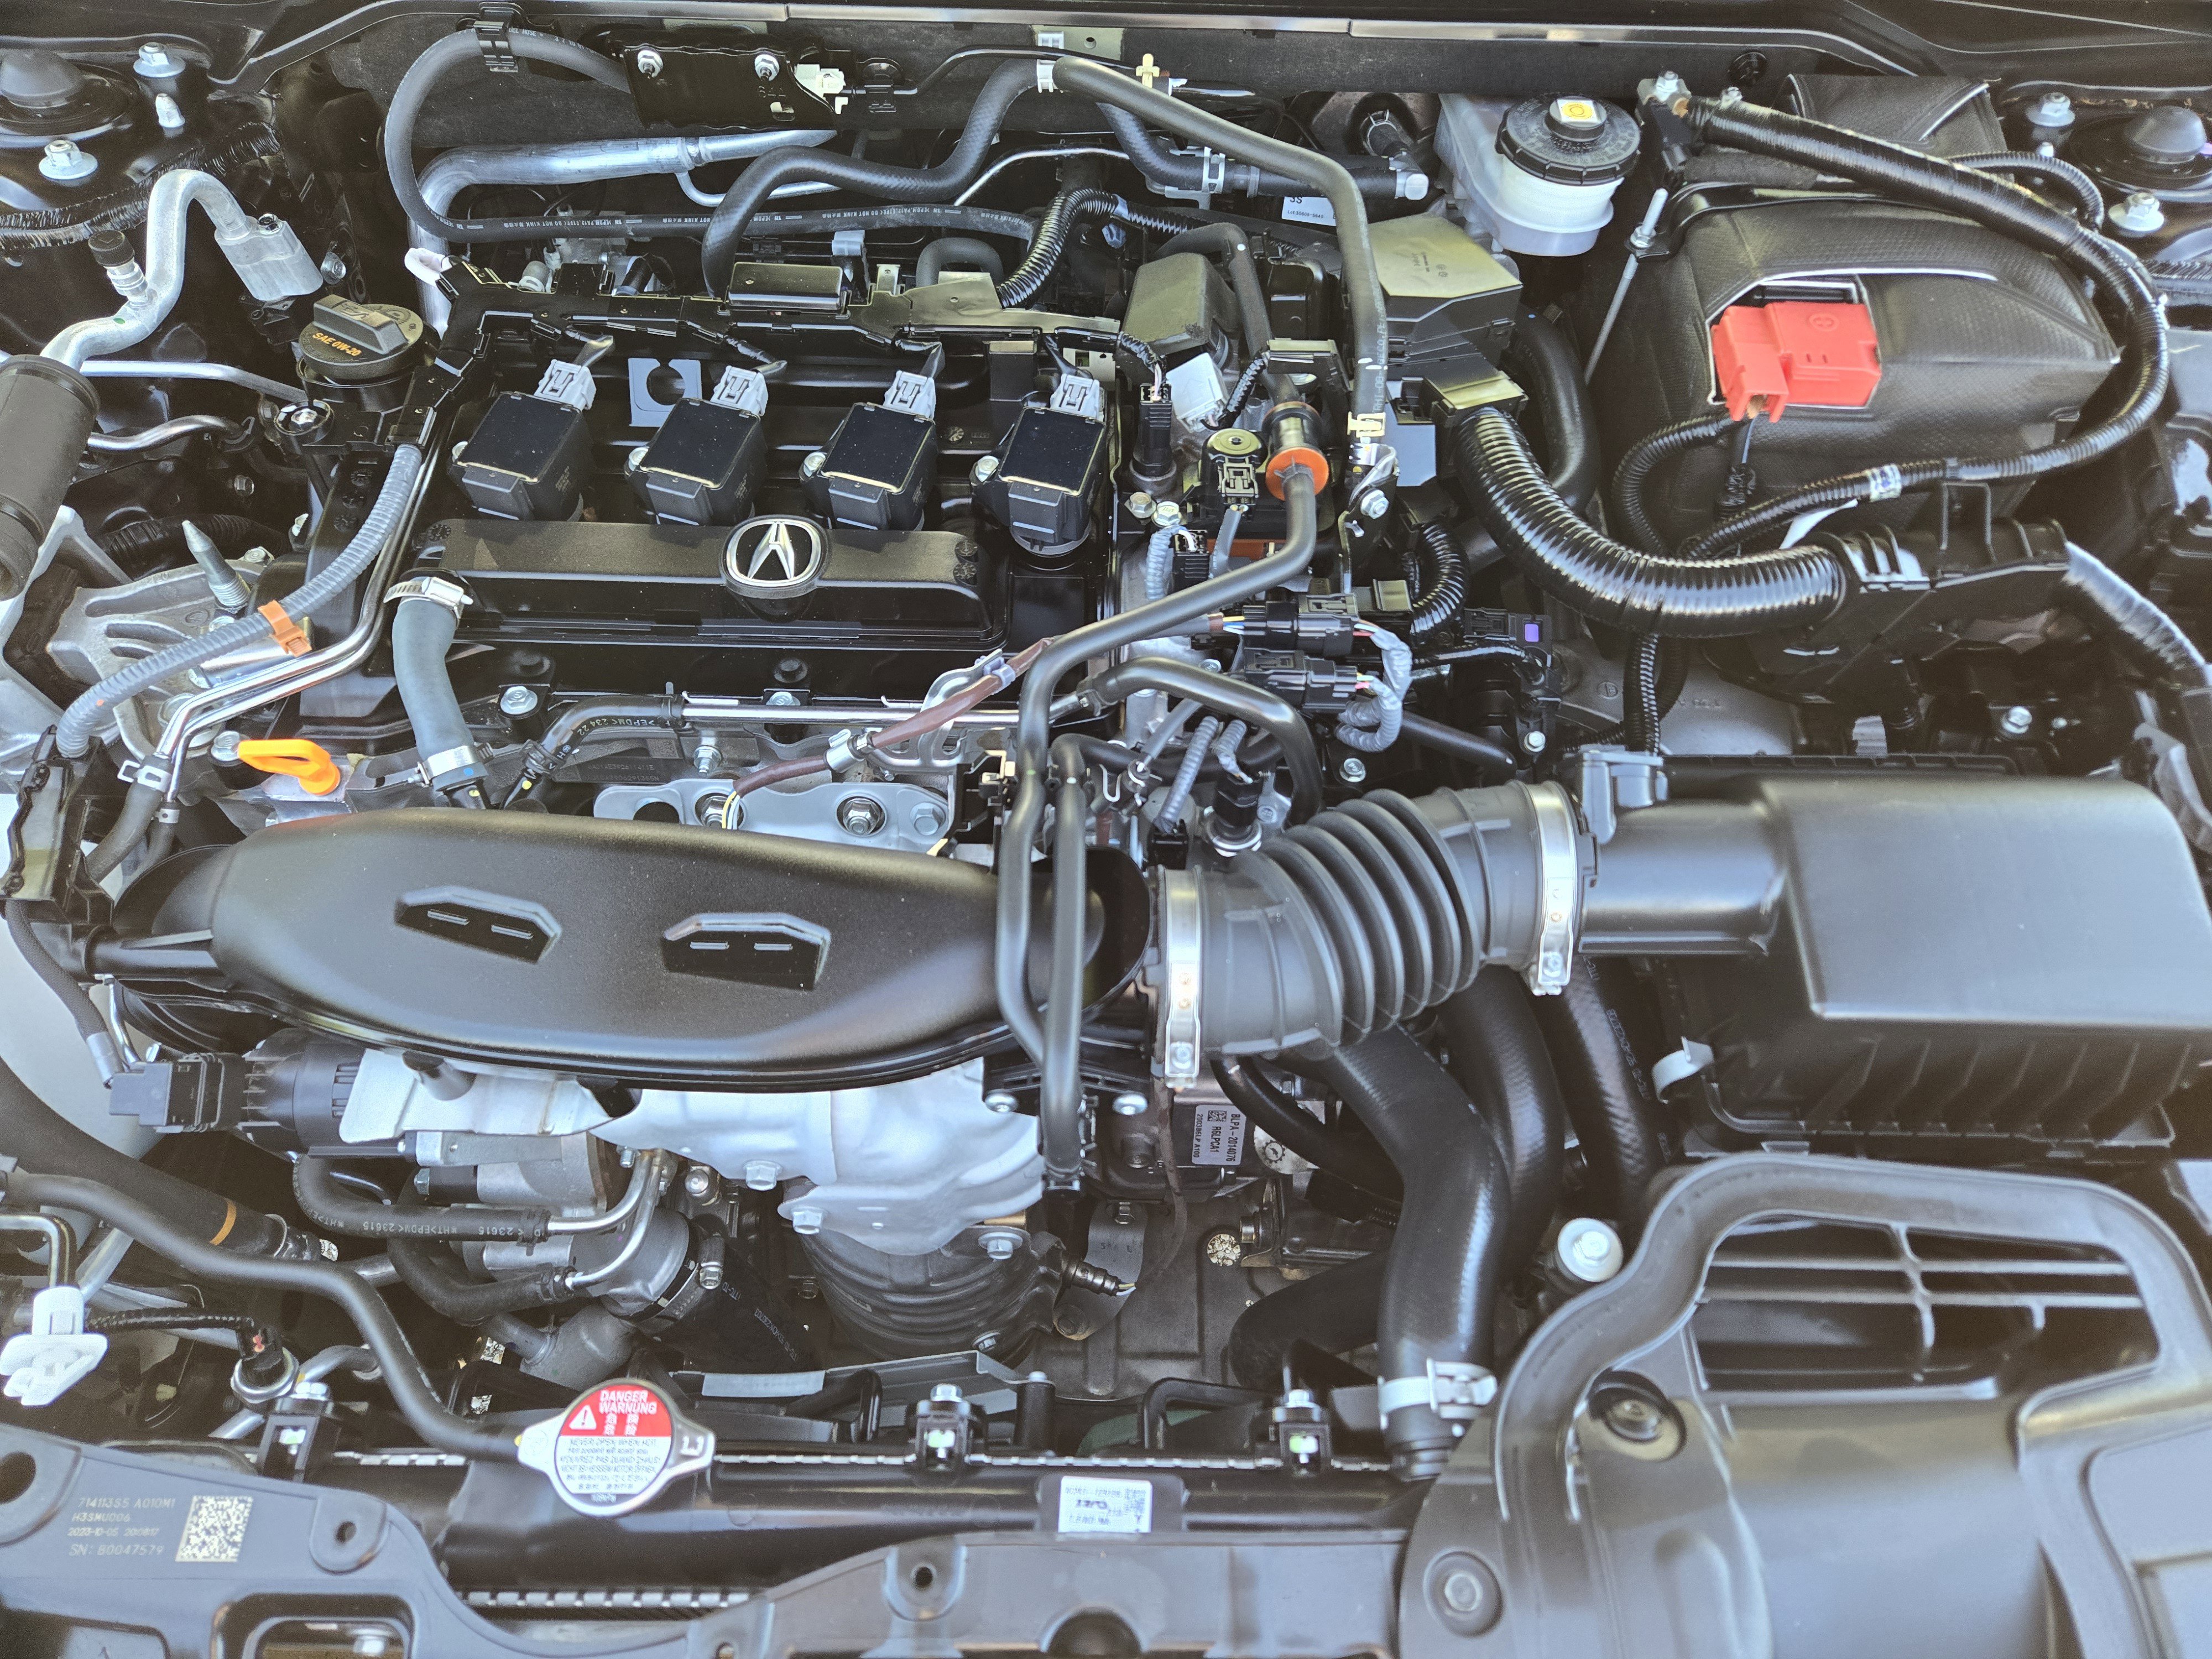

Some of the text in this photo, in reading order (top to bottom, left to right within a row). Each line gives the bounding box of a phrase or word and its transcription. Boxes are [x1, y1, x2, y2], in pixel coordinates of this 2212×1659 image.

[522, 29, 536, 37] HOSE
[312, 332, 362, 357] SAE 0W-20
[1209, 1126, 1222, 1153] R6LPCA1
[1226, 1114, 1240, 1162] BLPA-2014076
[599, 1390, 649, 1402] DANGER
[599, 1401, 657, 1415] WARNUNG
